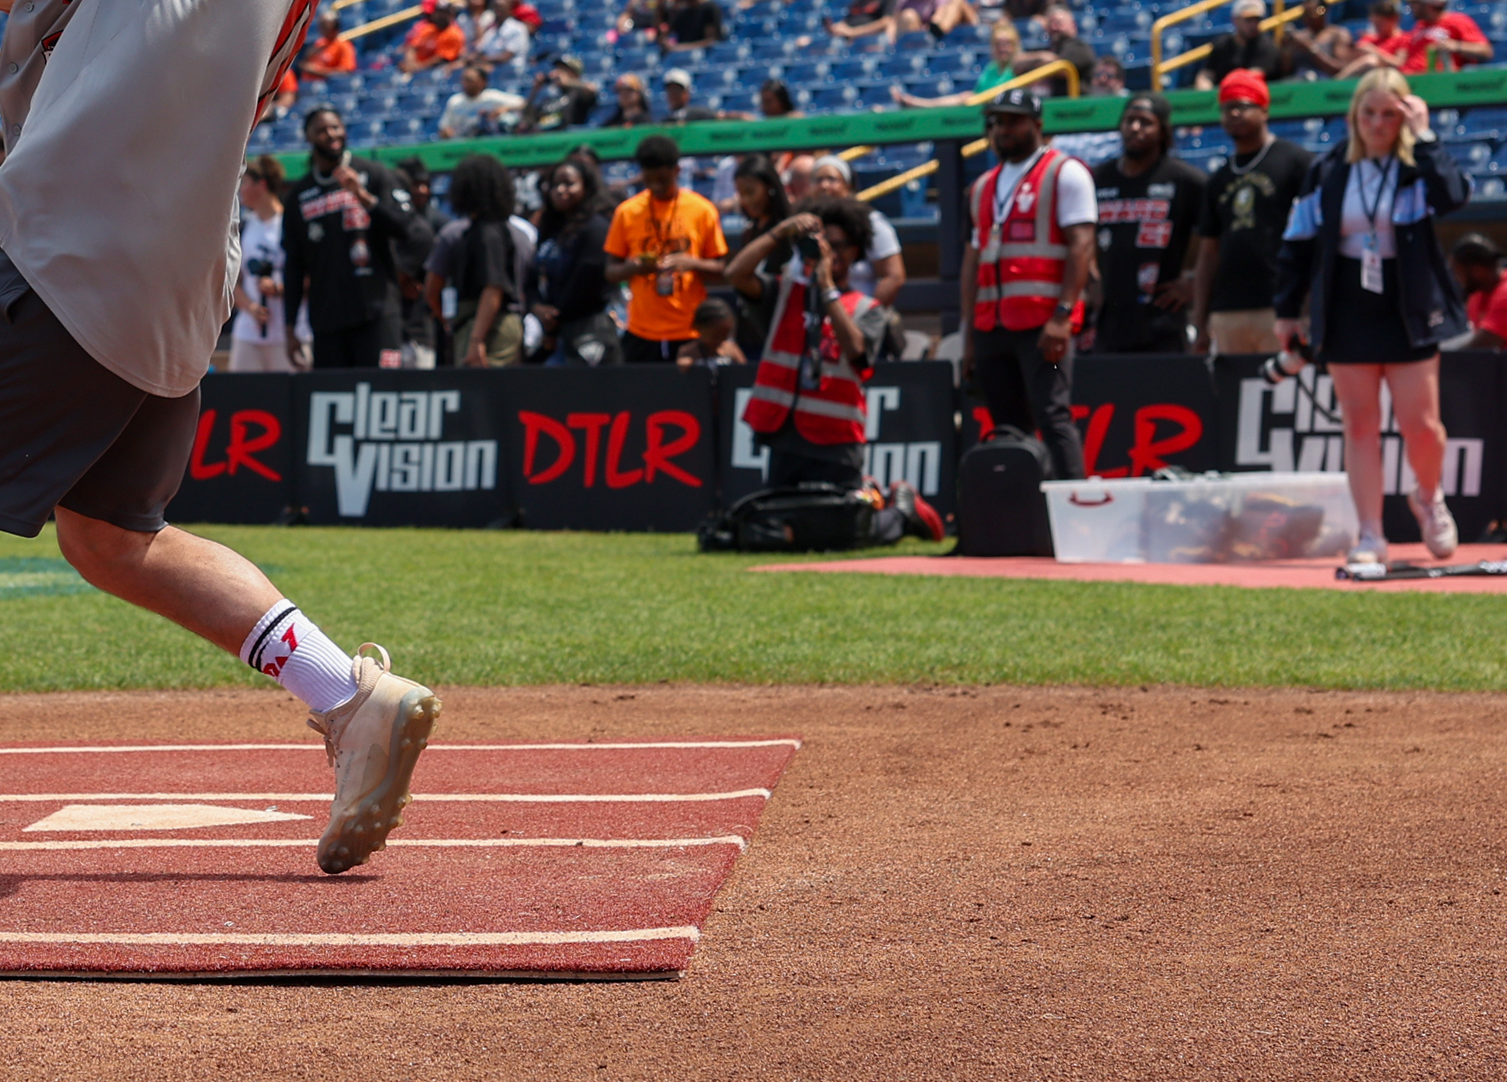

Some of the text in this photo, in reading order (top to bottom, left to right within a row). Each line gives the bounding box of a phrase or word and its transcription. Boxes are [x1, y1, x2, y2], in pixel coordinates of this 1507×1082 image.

[190, 408, 282, 482] LR
[307, 382, 461, 466] Clear
[518, 409, 703, 489] DTLR
[334, 434, 498, 516] Vision
